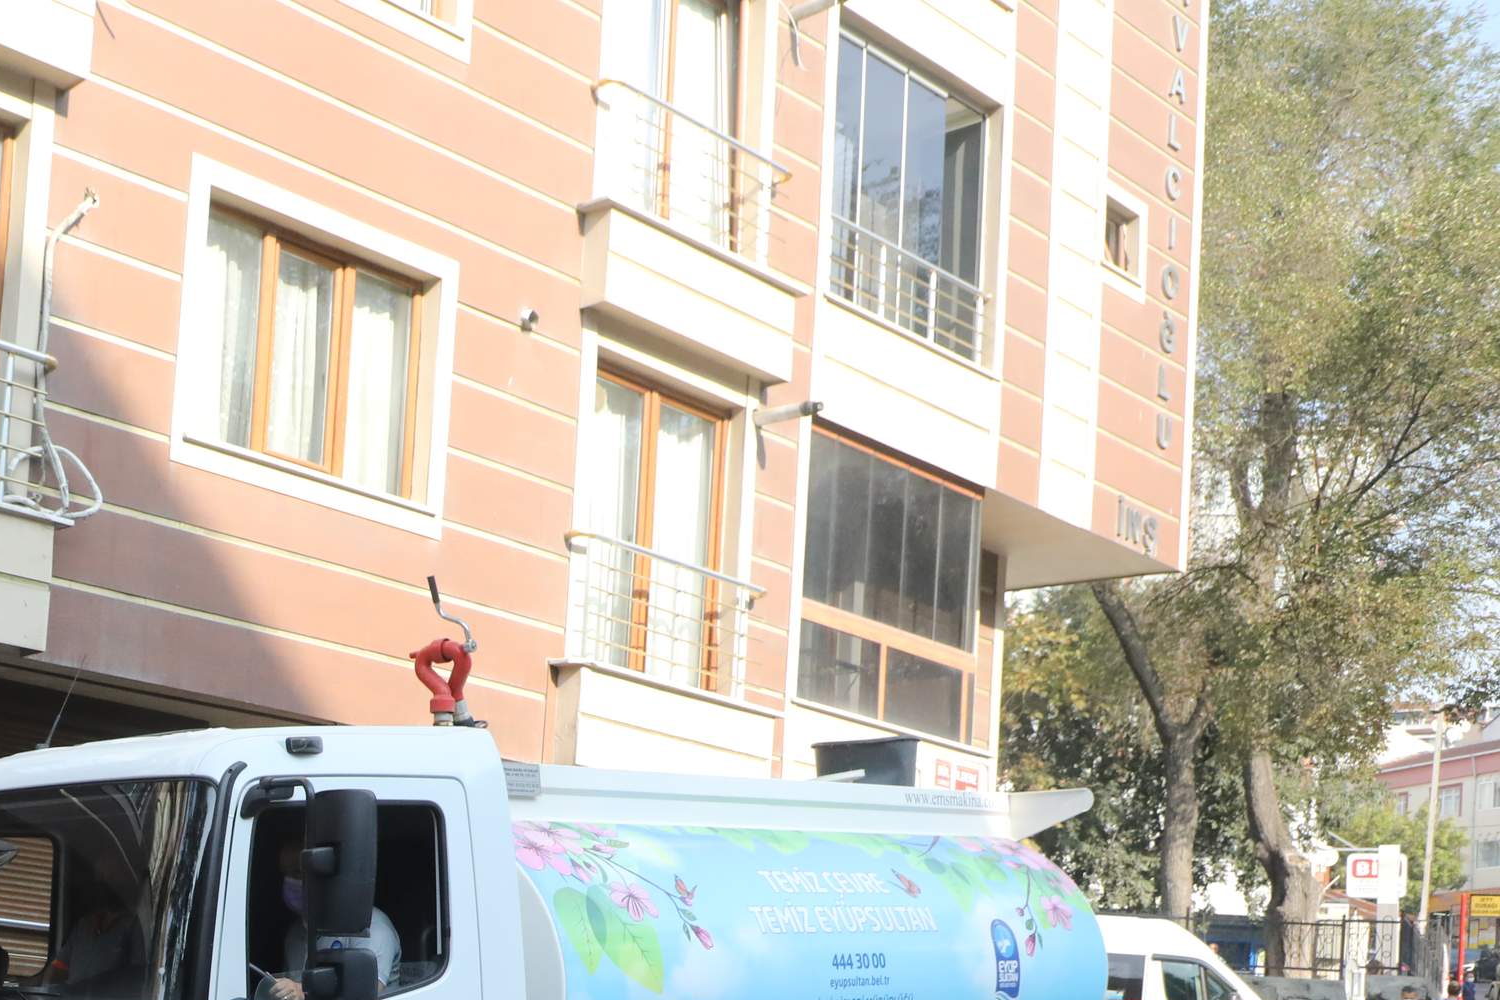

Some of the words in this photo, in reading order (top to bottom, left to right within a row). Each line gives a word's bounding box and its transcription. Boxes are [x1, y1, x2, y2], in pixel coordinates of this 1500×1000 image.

[1156, 0, 1189, 450] VALCIOĞLU
[905, 791, 997, 809] www.emsmakina.co
[756, 866, 829, 894] TEMİZ
[822, 871, 891, 898] ÇEVRE
[748, 901, 818, 934] TEMİZ
[814, 900, 940, 934] EYÜPSULTAN
[831, 953, 854, 970] 444
[855, 953, 870, 969] 30
[871, 953, 887, 969] 00
[829, 976, 890, 990] eyupsultan.bel.tr
